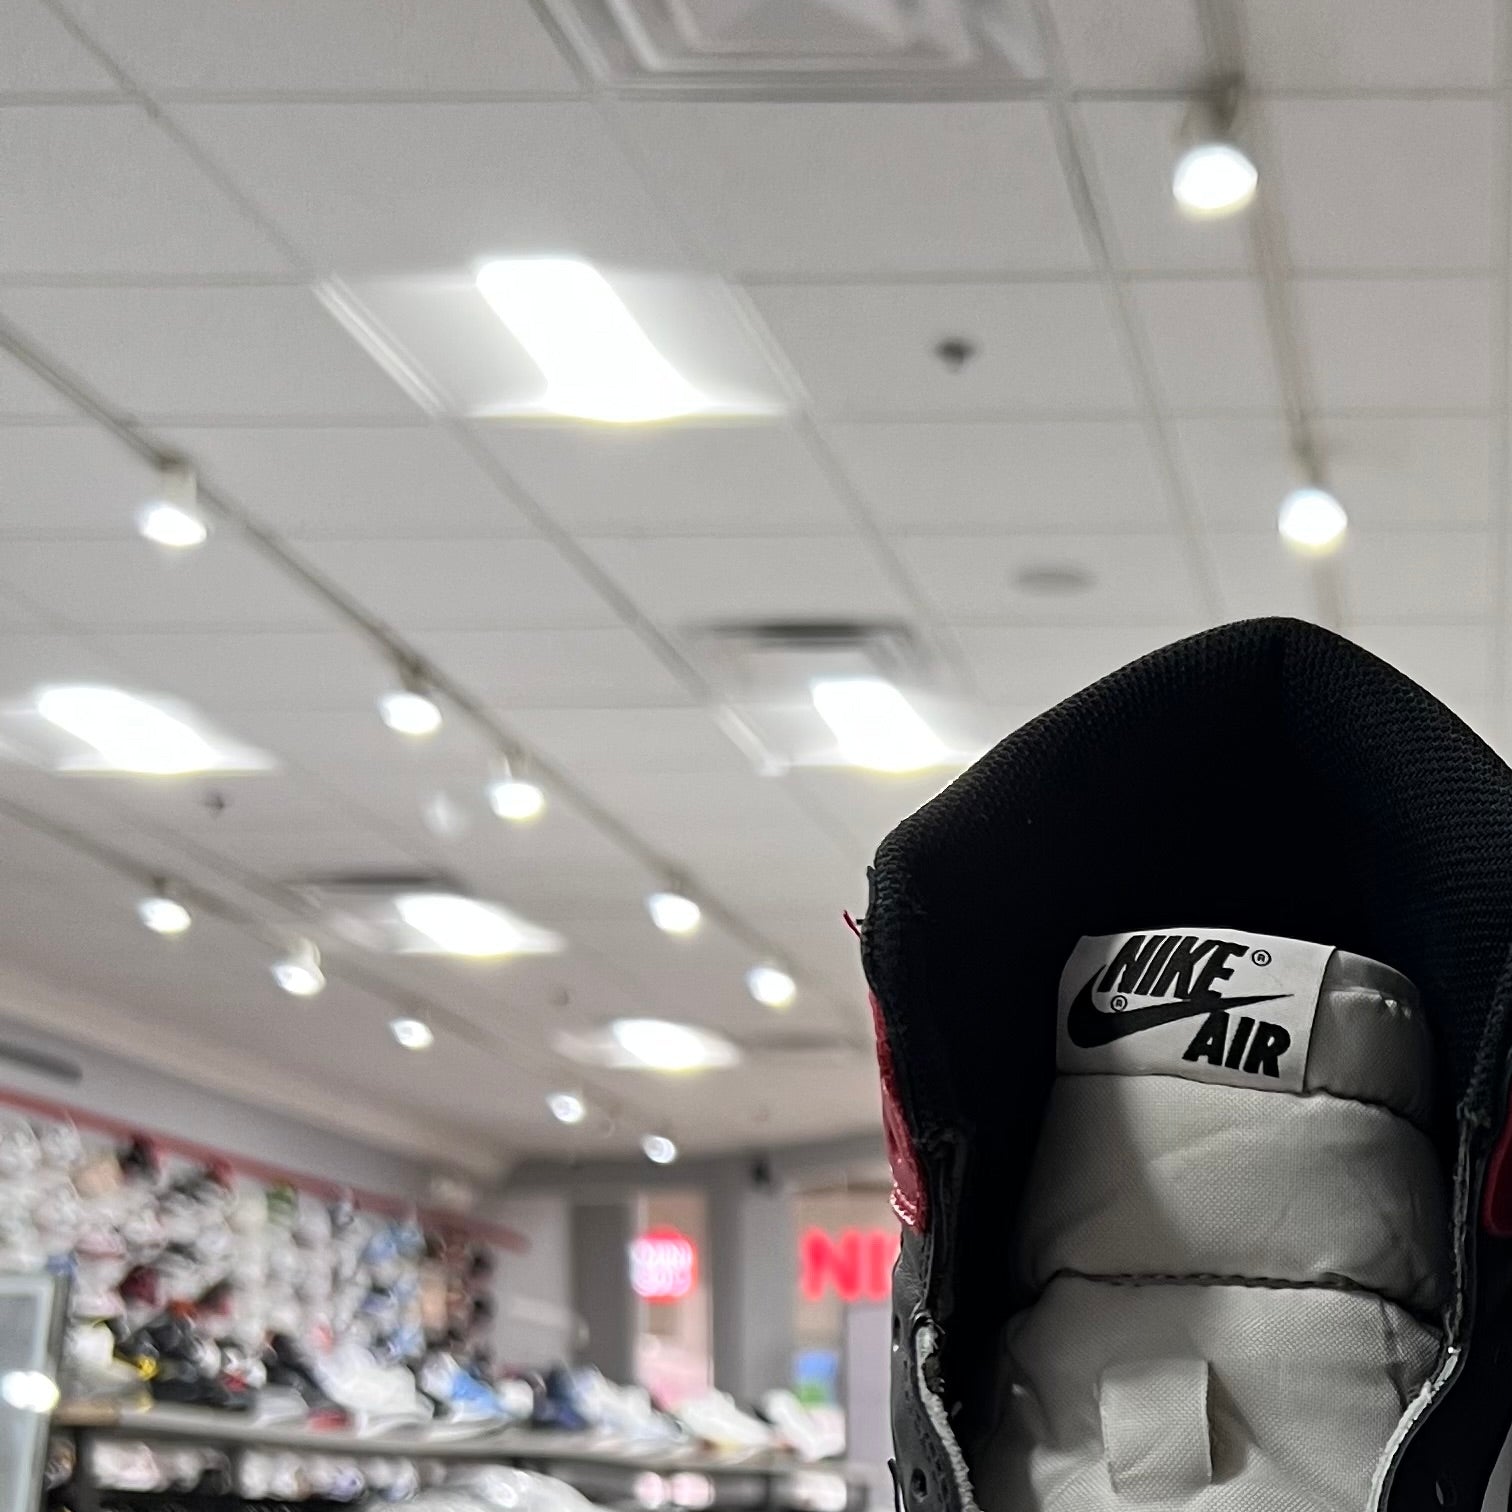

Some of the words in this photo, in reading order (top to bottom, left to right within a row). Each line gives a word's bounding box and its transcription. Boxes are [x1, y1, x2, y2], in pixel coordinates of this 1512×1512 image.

[1097, 935, 1250, 999] NIKE
[1182, 1010, 1290, 1078] AIR
[802, 1228, 899, 1301] NI
